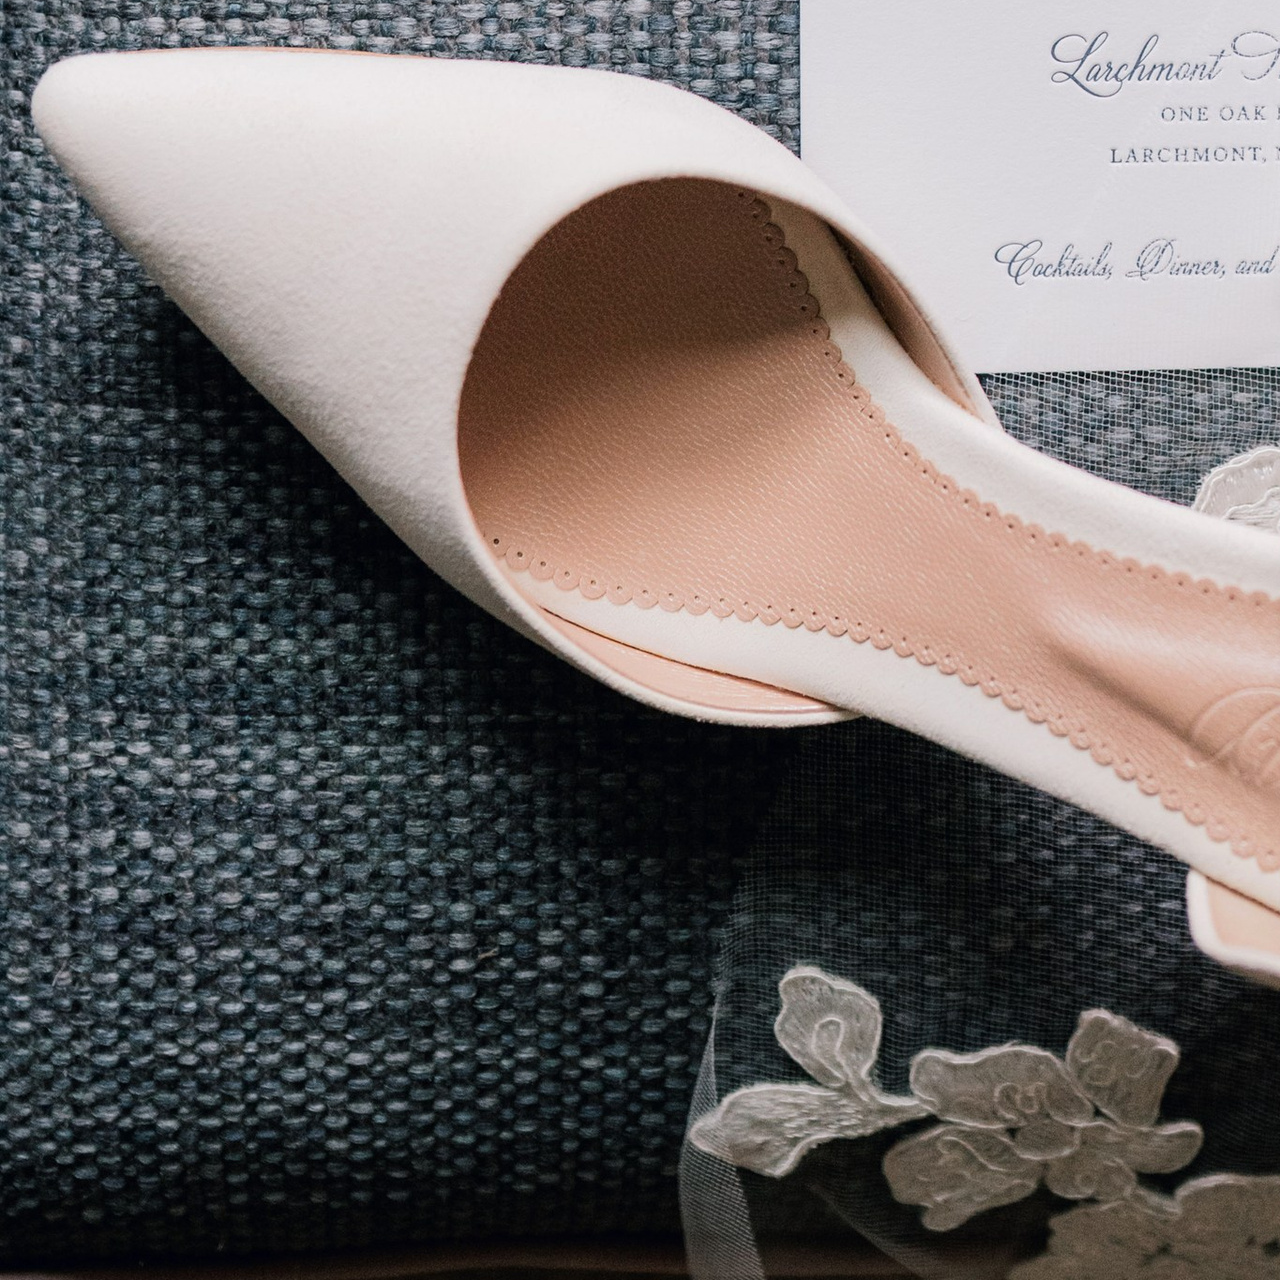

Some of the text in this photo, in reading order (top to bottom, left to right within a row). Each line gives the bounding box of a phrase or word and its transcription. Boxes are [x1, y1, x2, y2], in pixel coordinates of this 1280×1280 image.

[1050, 31, 1231, 98] Larchmont
[1160, 106, 1209, 122] ONE
[1219, 105, 1266, 122] OAK
[1110, 146, 1267, 164] LARCHMONT,
[994, 239, 1278, 286] Cocktails, Dinner, and
